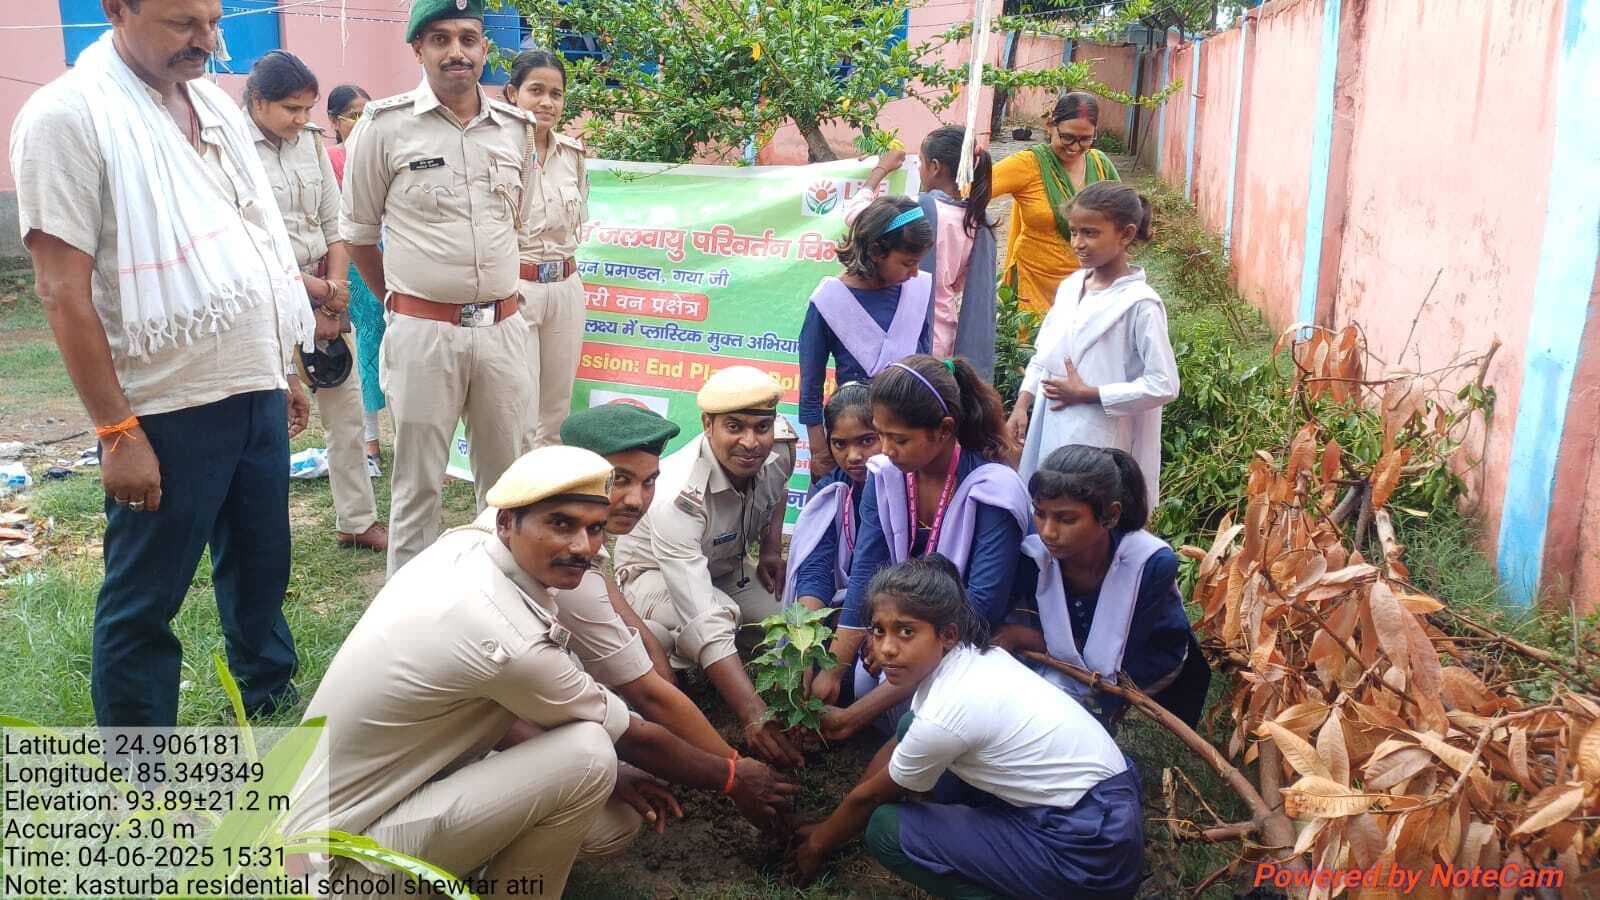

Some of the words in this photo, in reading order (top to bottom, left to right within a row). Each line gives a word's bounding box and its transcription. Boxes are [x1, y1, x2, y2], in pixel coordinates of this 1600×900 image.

[599, 228, 688, 262] जलवायु
[691, 225, 793, 258] परिवर्तन
[673, 270, 704, 285] गया
[708, 268, 730, 287] जी
[616, 294, 646, 311] वन
[651, 294, 701, 317] प्रक्षेत्र
[622, 319, 639, 336] में
[640, 322, 704, 343] प्लास्टिक
[707, 331, 745, 352] मुक्त
[747, 333, 800, 353] अभिया
[581, 352, 641, 374] ssion:
[645, 357, 684, 378] End
